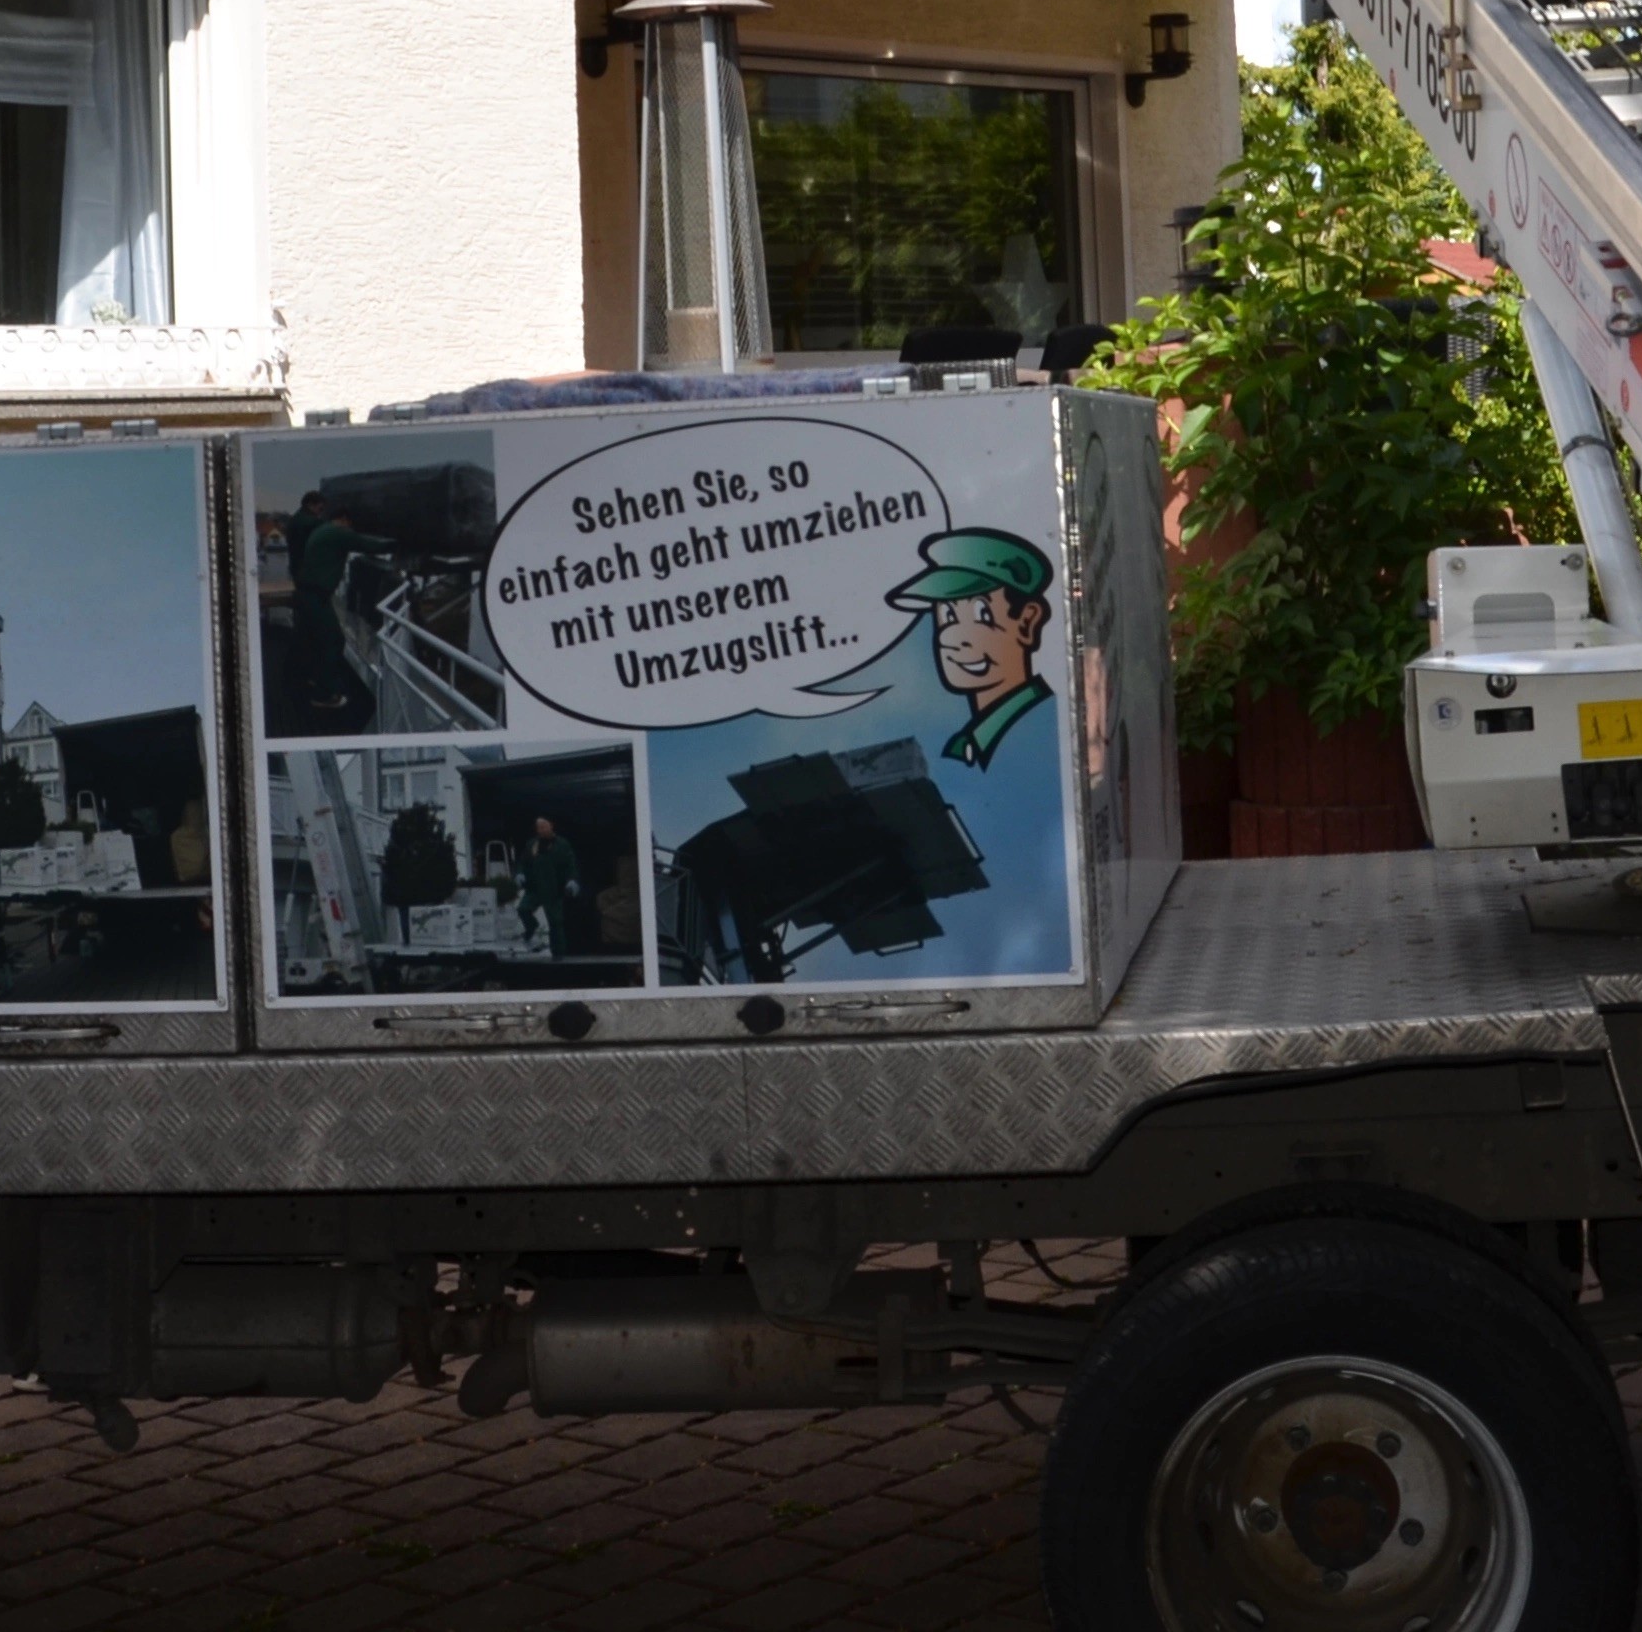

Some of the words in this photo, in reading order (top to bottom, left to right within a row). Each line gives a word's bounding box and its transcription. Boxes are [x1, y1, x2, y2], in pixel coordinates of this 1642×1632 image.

[572, 485, 684, 534] Sehen
[692, 469, 759, 510] Sie,
[768, 460, 810, 493] so
[498, 540, 640, 604] einfach
[649, 526, 730, 580] geht
[740, 490, 927, 554] umziehen
[550, 614, 615, 649] mit
[627, 574, 790, 632] unserem
[613, 615, 860, 689] Umzugslift...
